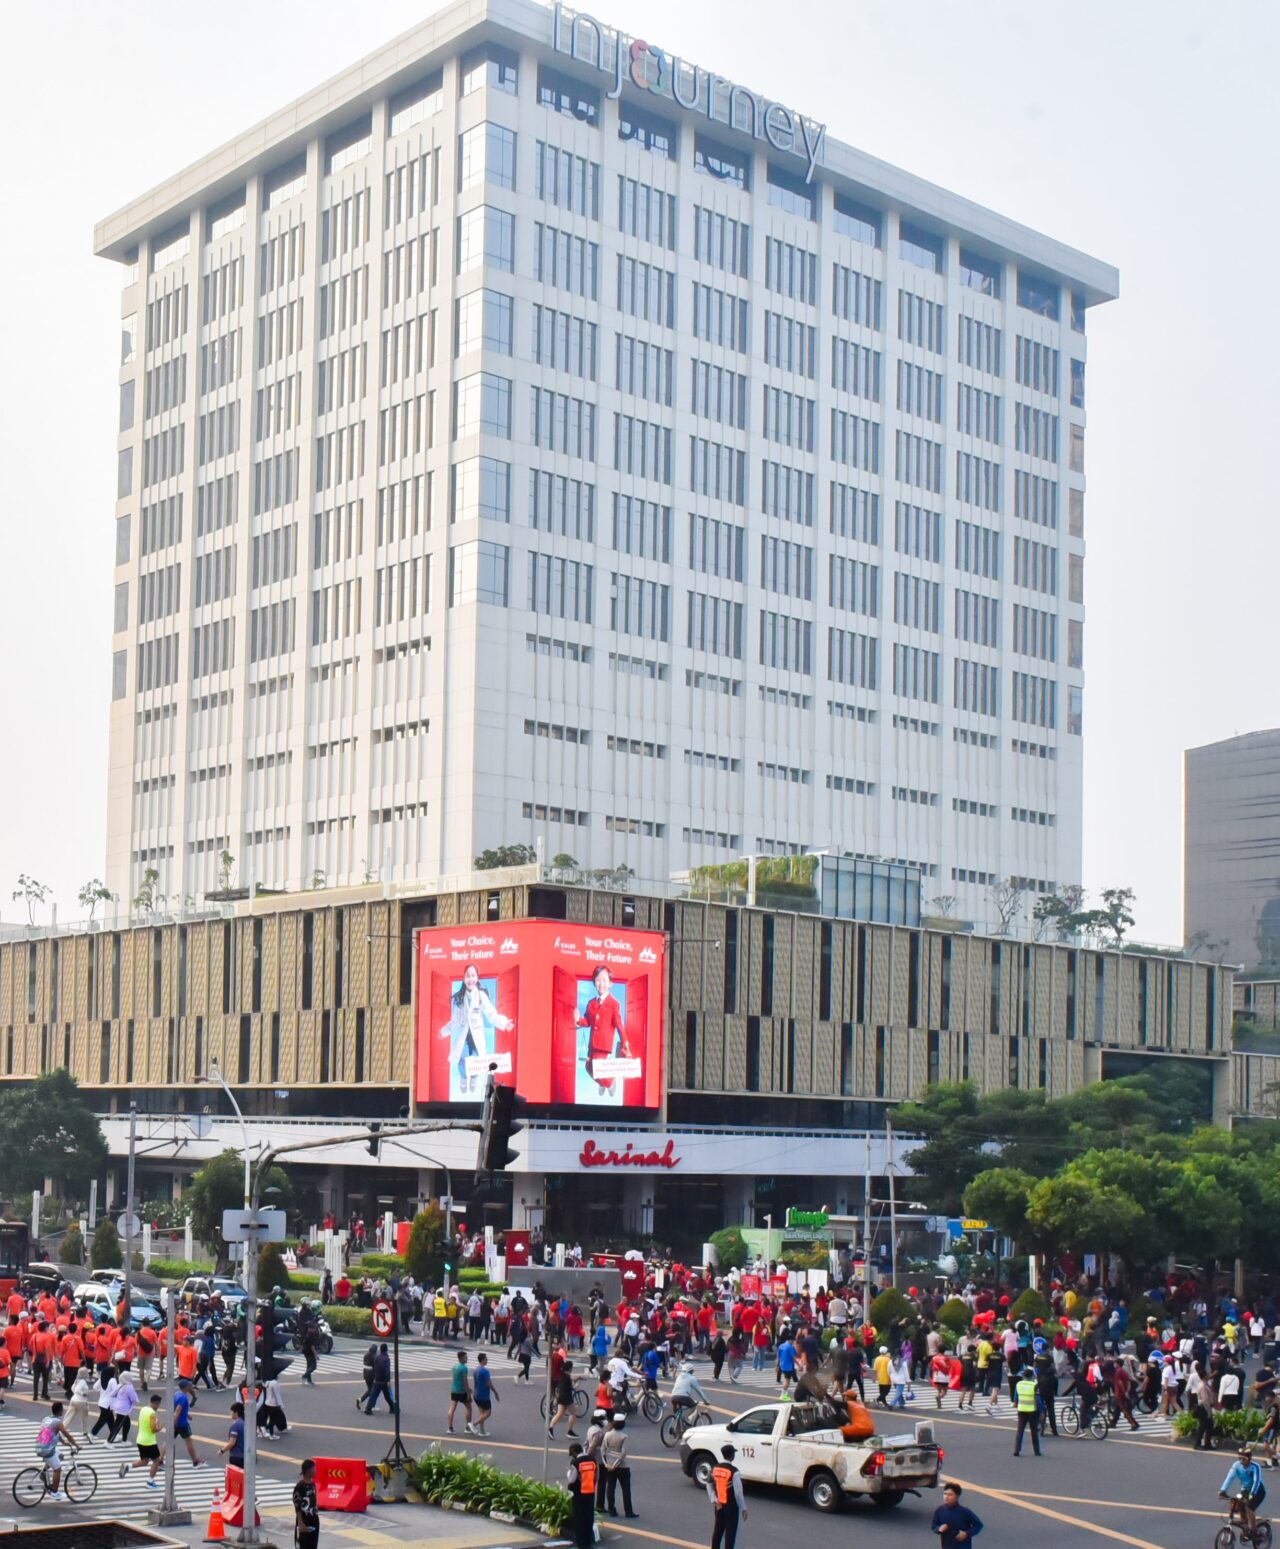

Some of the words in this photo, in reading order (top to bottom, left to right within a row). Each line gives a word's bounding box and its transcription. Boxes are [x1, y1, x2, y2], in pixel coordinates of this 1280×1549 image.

[450, 937, 466, 948] Your
[584, 936, 602, 947] Your
[451, 950, 469, 961] Their
[470, 949, 494, 960] Future
[585, 950, 605, 961] Their
[606, 952, 632, 964] Future
[579, 1139, 682, 1169] Sarinah
[742, 1447, 755, 1458] 112
